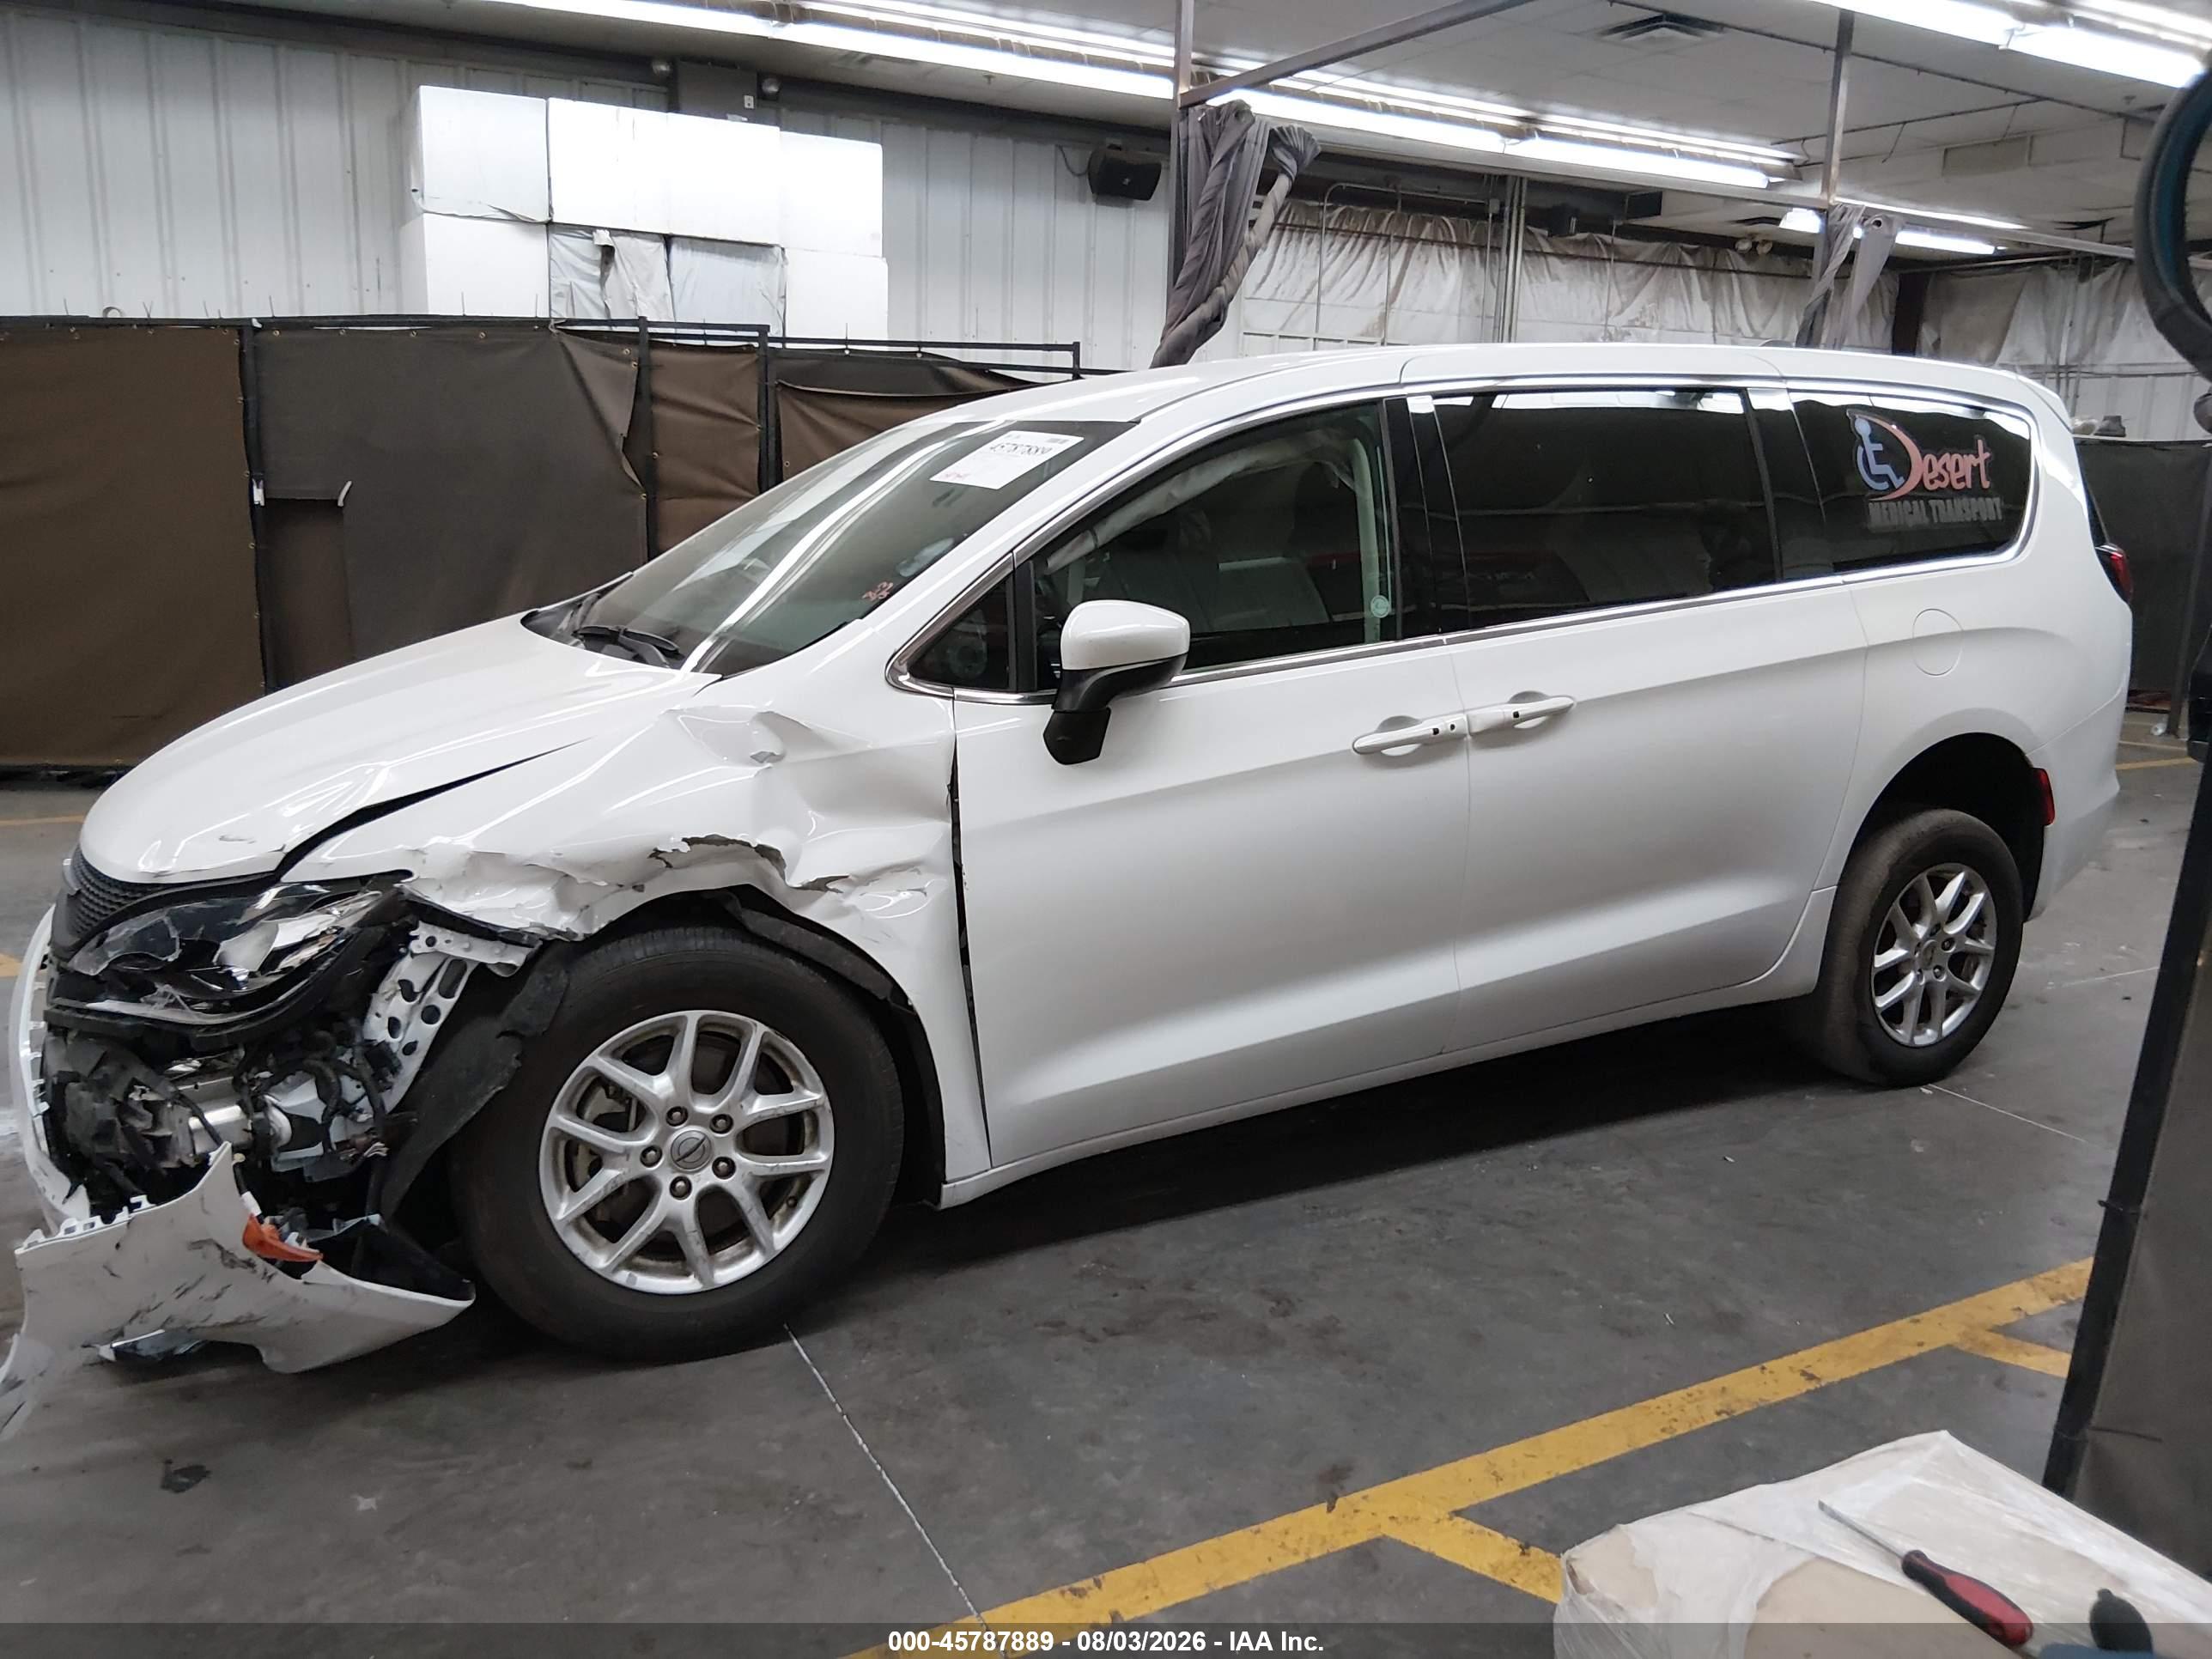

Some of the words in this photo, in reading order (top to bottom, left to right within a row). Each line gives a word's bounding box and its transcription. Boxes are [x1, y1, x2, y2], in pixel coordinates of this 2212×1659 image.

[1846, 409, 1990, 501] Desert
[1869, 500, 1929, 527] MEDICAL
[1929, 497, 2002, 523] TRANSPORT
